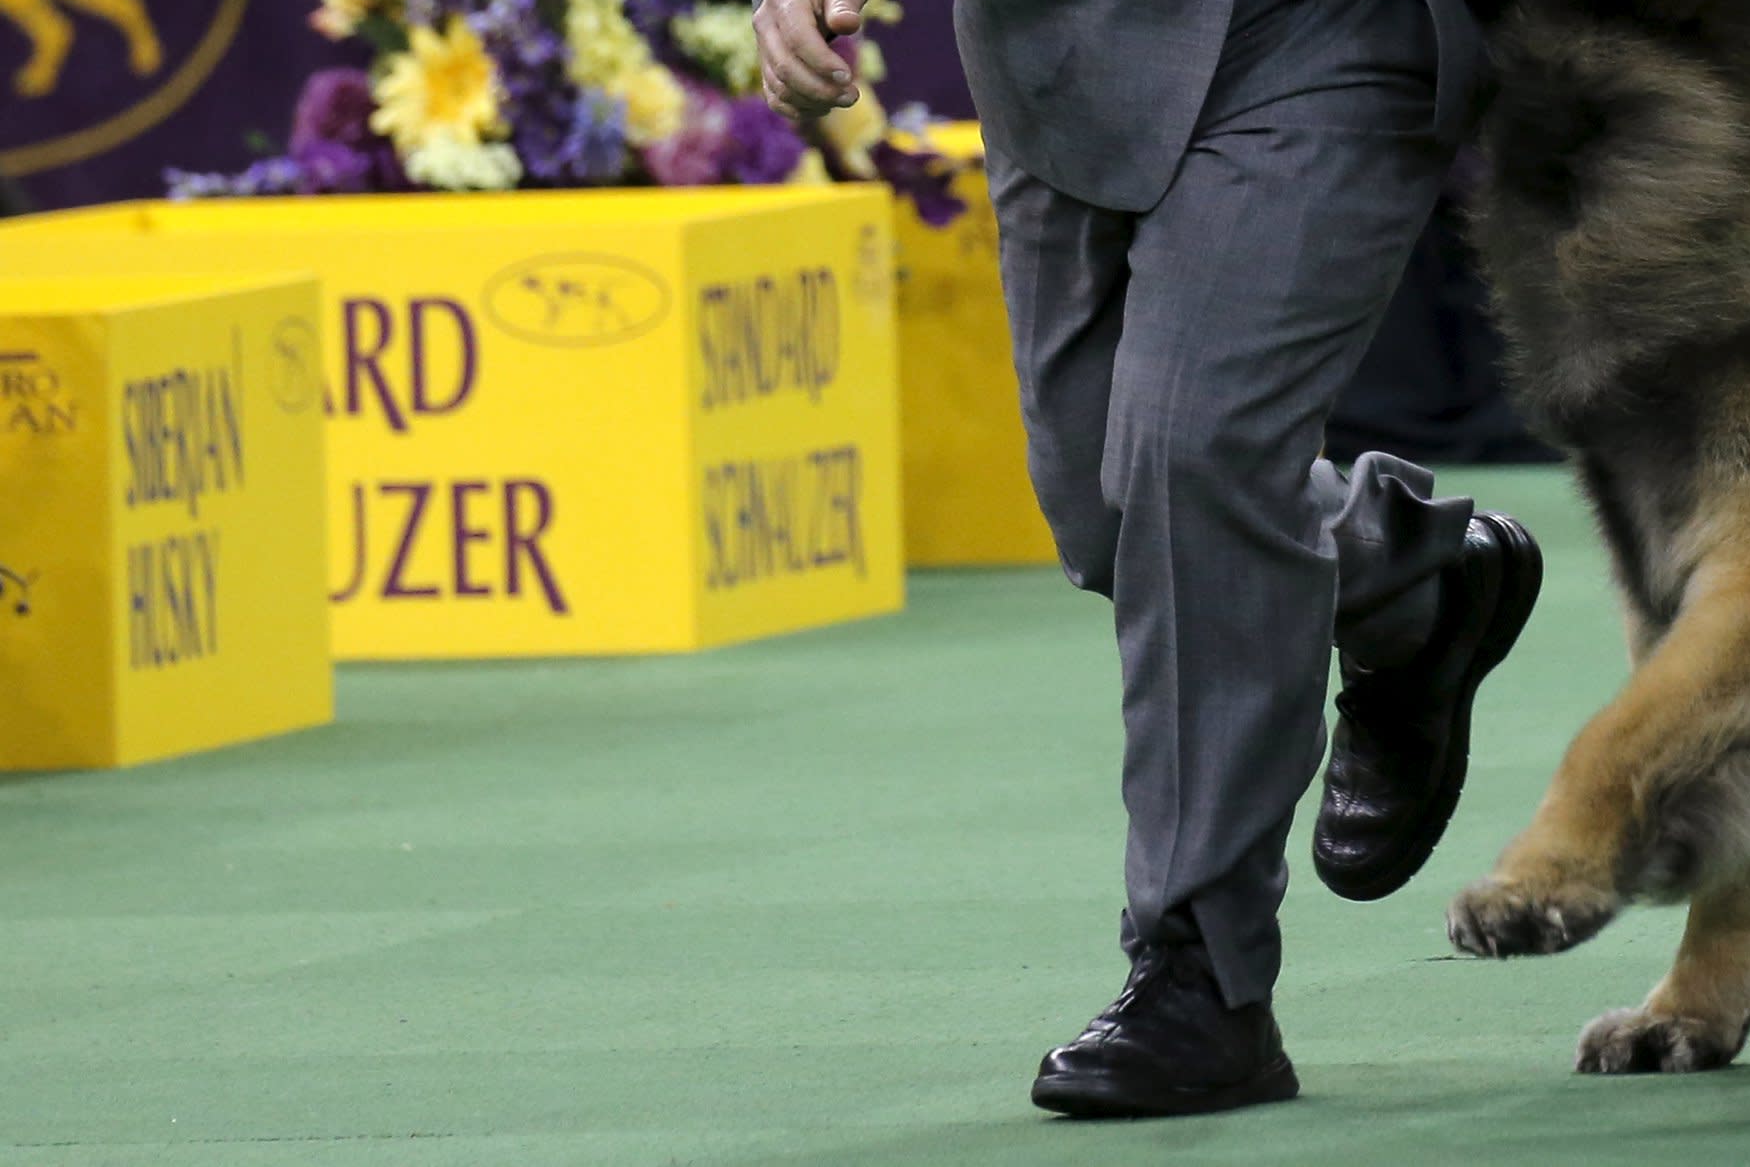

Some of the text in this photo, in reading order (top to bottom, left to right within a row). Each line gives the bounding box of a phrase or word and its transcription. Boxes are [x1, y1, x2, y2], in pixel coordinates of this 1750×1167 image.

[698, 265, 842, 409] STANDARD
[123, 322, 246, 519] SIBERIAN
[703, 445, 868, 590] SCHNAUZER
[128, 528, 220, 669] HUSKY
